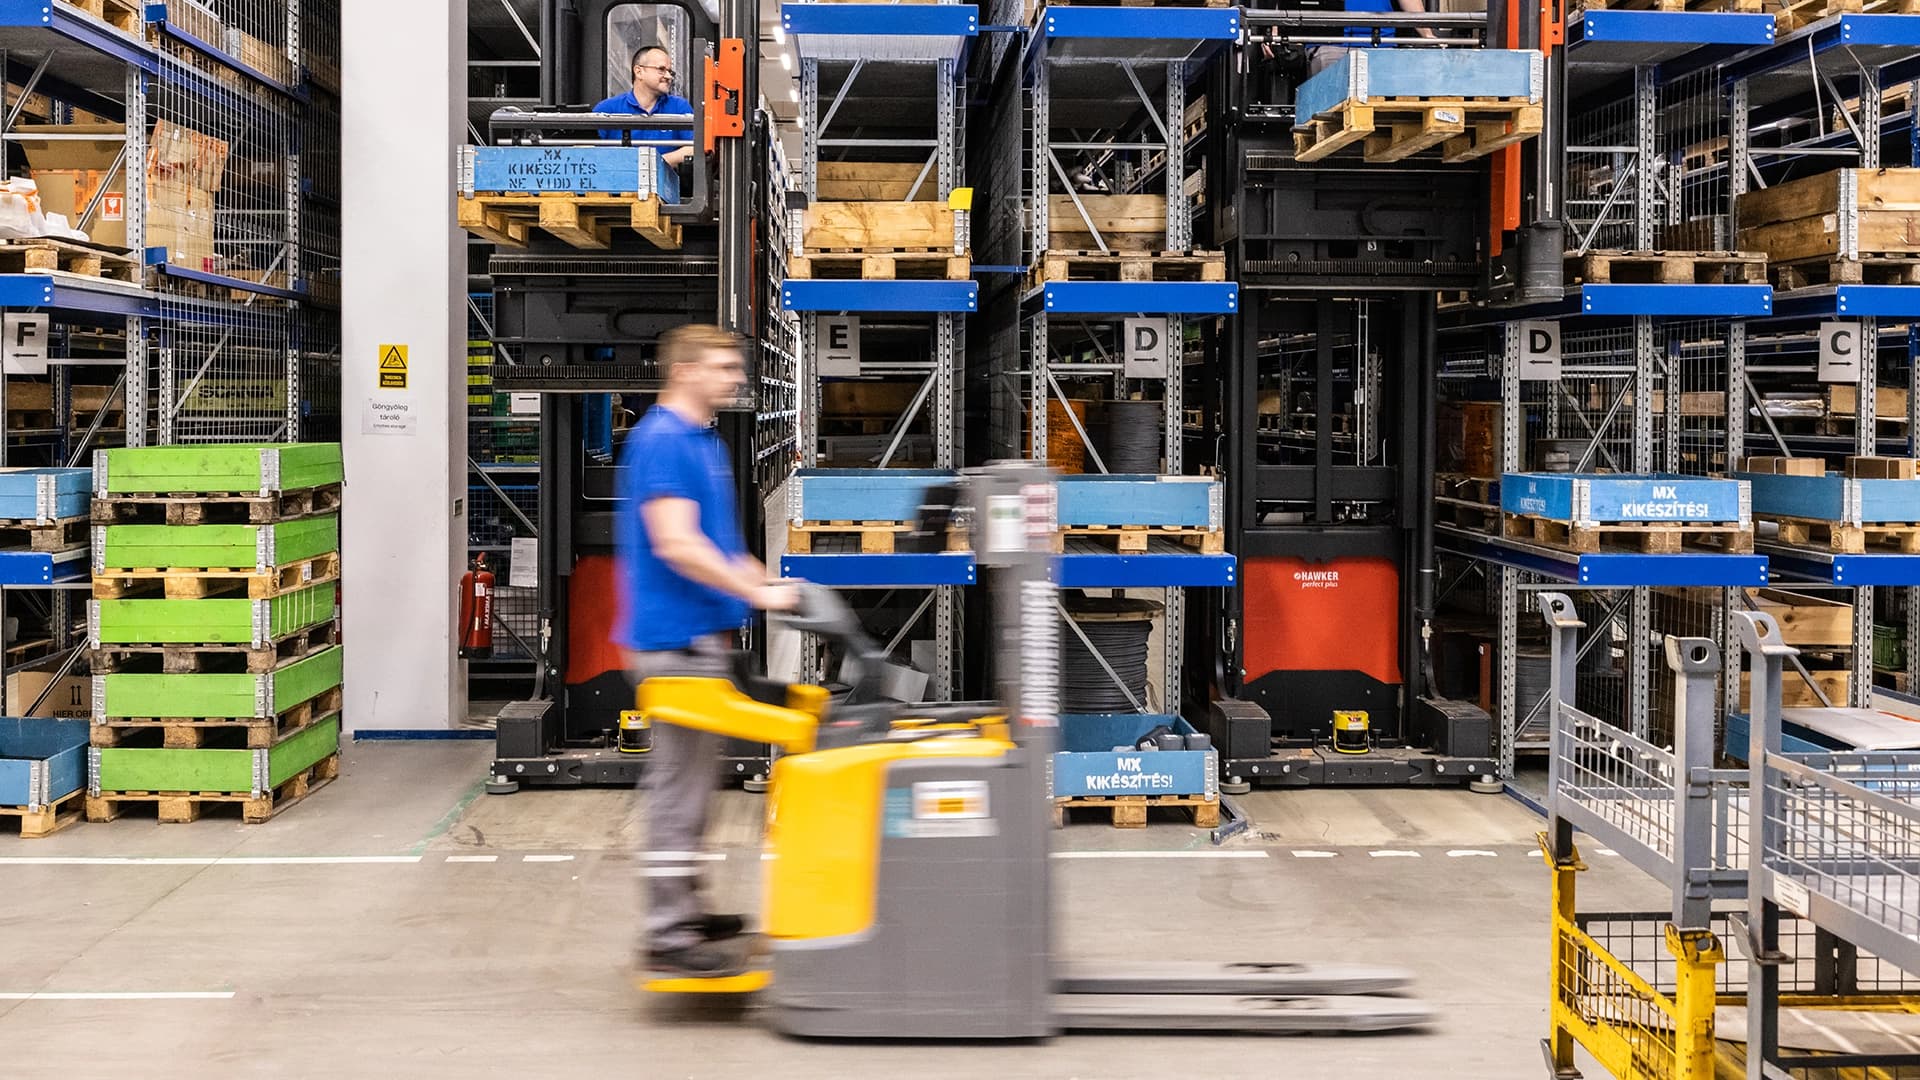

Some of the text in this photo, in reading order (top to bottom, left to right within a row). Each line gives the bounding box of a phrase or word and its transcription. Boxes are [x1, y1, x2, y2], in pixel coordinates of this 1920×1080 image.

[544, 149, 562, 160] MX
[509, 178, 597, 189] NE VIDD EL
[17, 322, 37, 347] F
[830, 325, 848, 349] E
[1135, 327, 1158, 351] D
[1529, 329, 1552, 353] D
[1831, 330, 1851, 355] C
[1652, 486, 1677, 499] MX
[1301, 571, 1339, 581] HAWKER
[1302, 581, 1324, 590] perfect
[53, 710, 74, 718] HIER
[1117, 757, 1142, 772] MX
